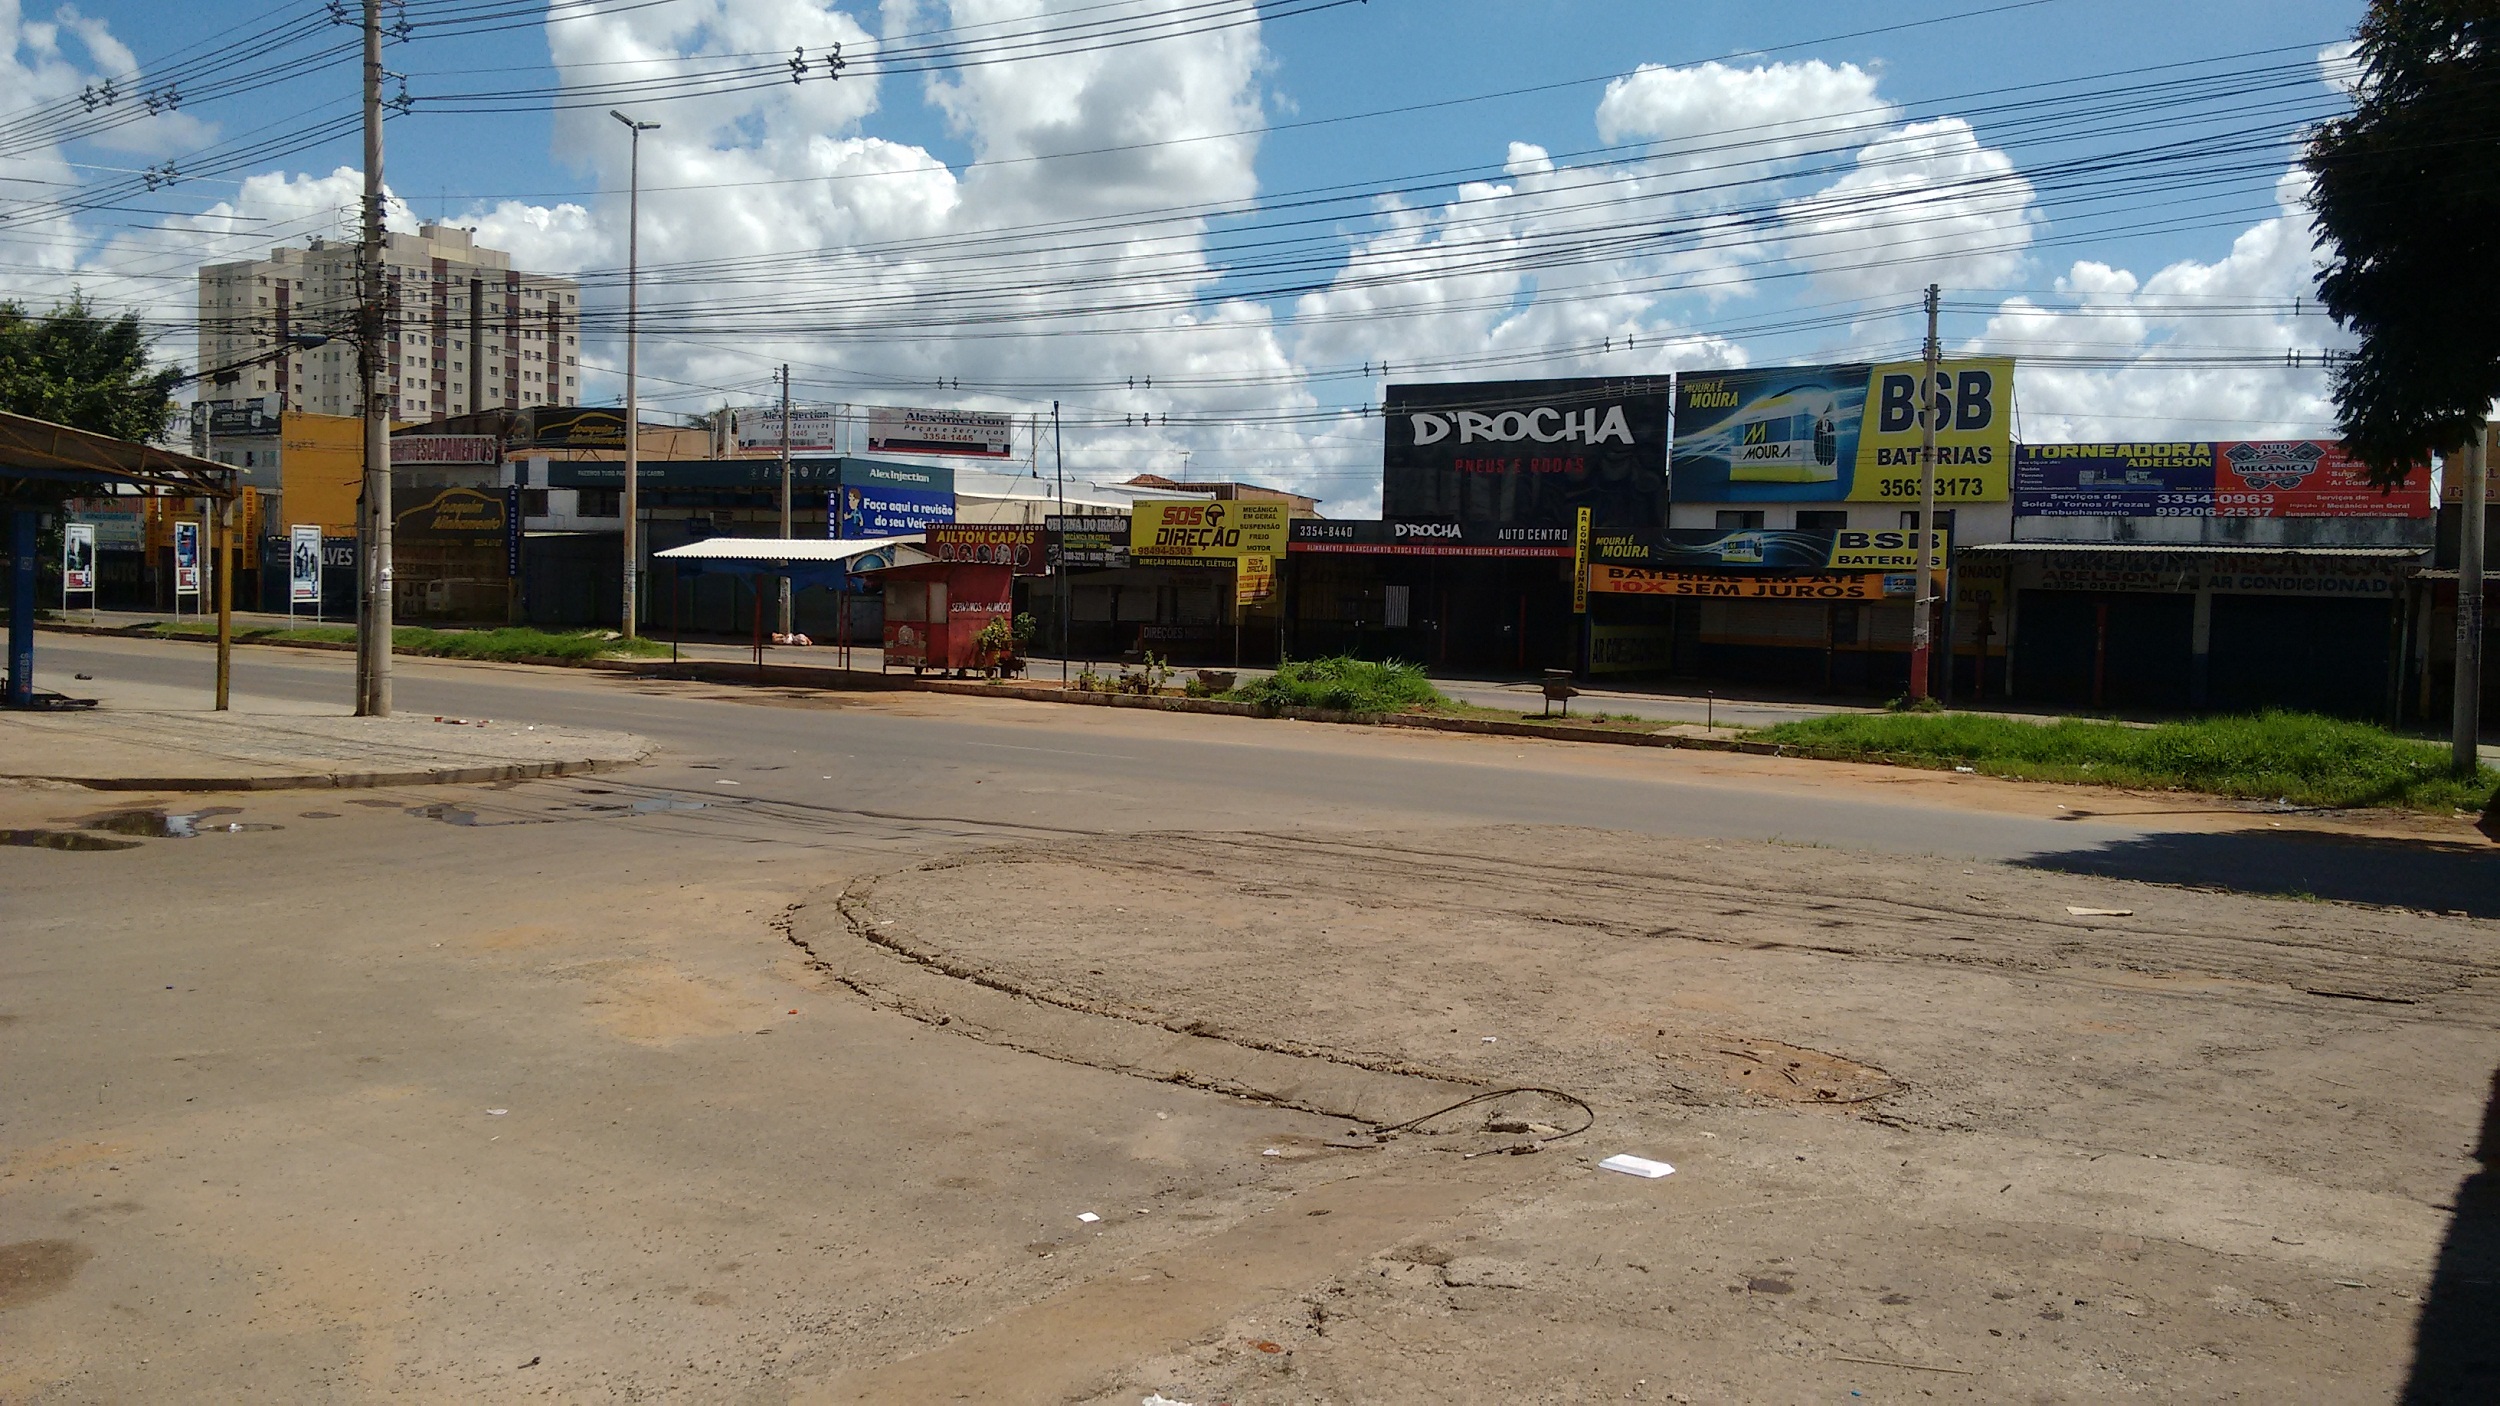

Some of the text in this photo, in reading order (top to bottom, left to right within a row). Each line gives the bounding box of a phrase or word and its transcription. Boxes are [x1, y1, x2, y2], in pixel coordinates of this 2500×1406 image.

[1684, 382, 1715, 394] MOURA
[1689, 391, 1739, 409] MOURA
[1879, 370, 1992, 432] BSB
[952, 426, 1005, 436] Serviços
[1410, 405, 1636, 446] D'ROCHA
[1743, 444, 1791, 460] MOURA
[1877, 446, 1992, 466] BATRIAS
[2023, 443, 2211, 459] TORNEADORA
[1454, 457, 1585, 473] PNEUS E RODAS
[2126, 457, 2212, 468] ADELSON
[2050, 493, 2100, 501] Serviços
[2157, 494, 2275, 504] 3354-0963
[863, 498, 954, 516] Faça aqui a revisão
[2040, 509, 2130, 517] Embuchamento
[2156, 507, 2274, 517] 99206-2537
[874, 515, 888, 527] do
[889, 517, 905, 528] seu
[1161, 506, 1205, 526] SOS
[1240, 522, 1280, 530] SUSPENSÃO
[1300, 526, 1353, 538] 3354-8440
[1394, 523, 1463, 538] D'ROCHA
[936, 530, 1035, 544] AILTON CAPAS
[1155, 526, 1241, 550] DIREÇÃO
[1498, 528, 1568, 541] AUTO CENTRO
[1595, 536, 1628, 546] MOURA
[1601, 545, 1649, 558] MOURA
[1139, 557, 1166, 568] DIREÇÃO
[1206, 558, 1236, 568] ELÉTRICA
[1577, 525, 1587, 602] CONDICIONADO
[1838, 555, 1941, 566] BATERIS
[1610, 580, 1865, 598] 10X SEM JUROS
[2207, 576, 2233, 589] AR
